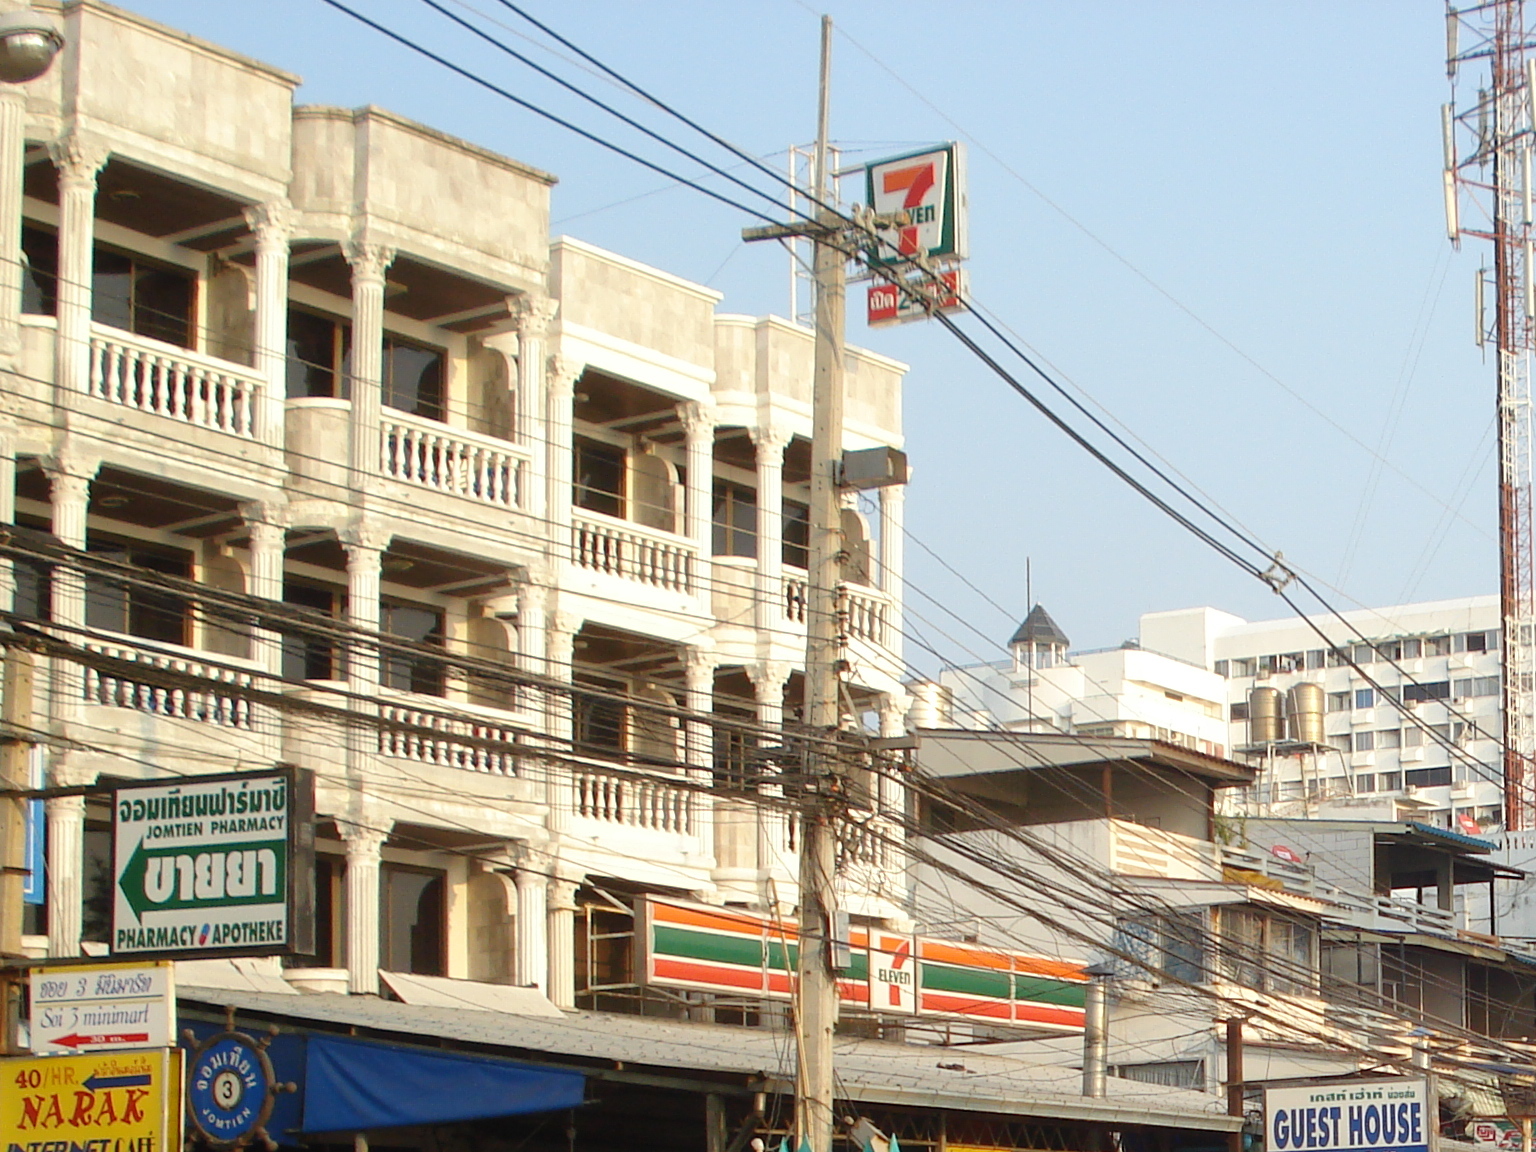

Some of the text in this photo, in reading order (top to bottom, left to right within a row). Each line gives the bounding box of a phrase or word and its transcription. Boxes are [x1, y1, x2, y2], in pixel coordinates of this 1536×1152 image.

[883, 161, 935, 256] 7
[146, 815, 285, 839] JOMTIEN PHARMACY
[143, 848, 277, 903] ขายยา
[117, 920, 283, 949] PHARMACY APOTHEKE
[879, 936, 910, 1006] 7
[76, 977, 87, 996] 3
[40, 1003, 149, 1029] Soi 3 minimart
[90, 1035, 106, 1043] 30
[222, 1081, 233, 1099] 3
[16, 1088, 149, 1130] NARAK
[202, 1107, 251, 1130] JOMTIEN
[1273, 1102, 1421, 1149] GUEST HOUSE
